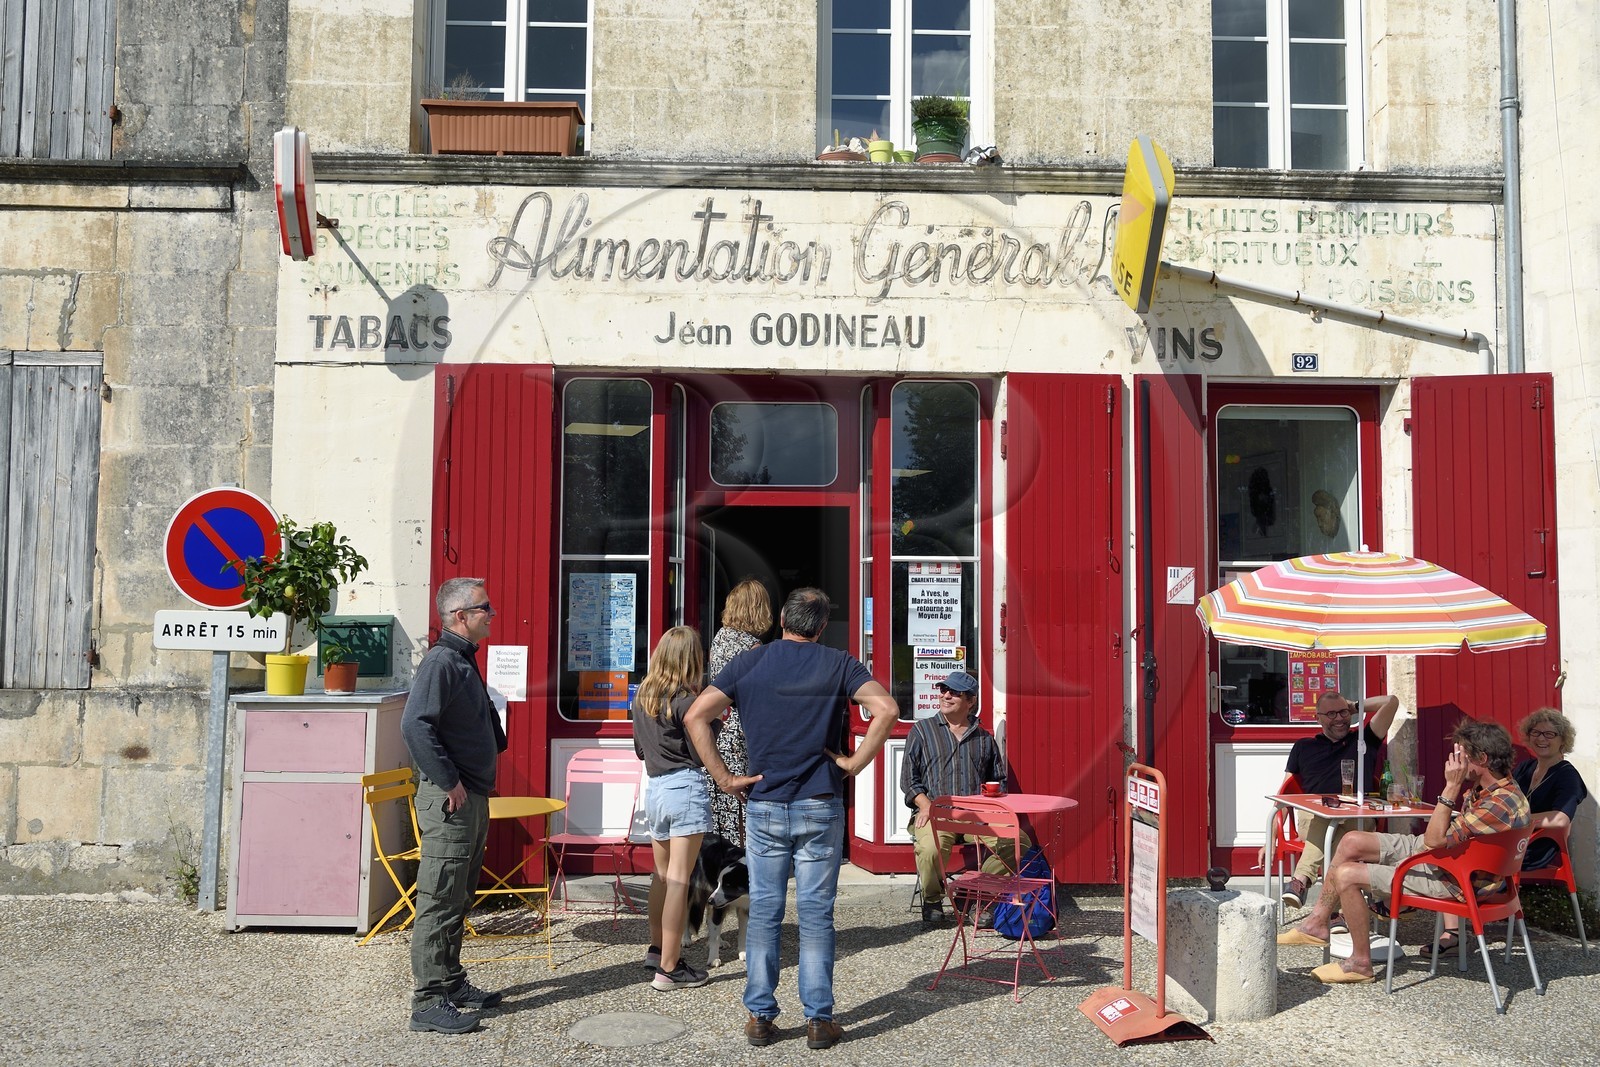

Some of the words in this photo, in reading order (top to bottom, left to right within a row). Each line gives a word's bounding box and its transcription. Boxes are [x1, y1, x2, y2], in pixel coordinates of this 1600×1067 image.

[1297, 210, 1455, 236] PRIMEURS
[486, 191, 832, 288] Alimentation
[857, 200, 1118, 305] Général
[301, 262, 461, 286] SOUVENIRS
[1328, 278, 1476, 304] POISSONS
[308, 315, 452, 350] TABACS
[654, 311, 732, 346] Jean
[750, 312, 927, 349] GODINEAU
[1126, 326, 1223, 361] VINS
[1296, 355, 1315, 369] 92
[1167, 570, 1195, 598] LICENCE
[911, 597, 933, 605] Marais
[943, 597, 959, 605] selle
[916, 605, 943, 613] retourne
[918, 612, 939, 620] Moyen
[162, 622, 218, 638] ARRÊT
[227, 625, 245, 638] 15
[253, 627, 277, 639] min
[915, 662, 929, 670] Les
[931, 661, 964, 670] Nouillers
